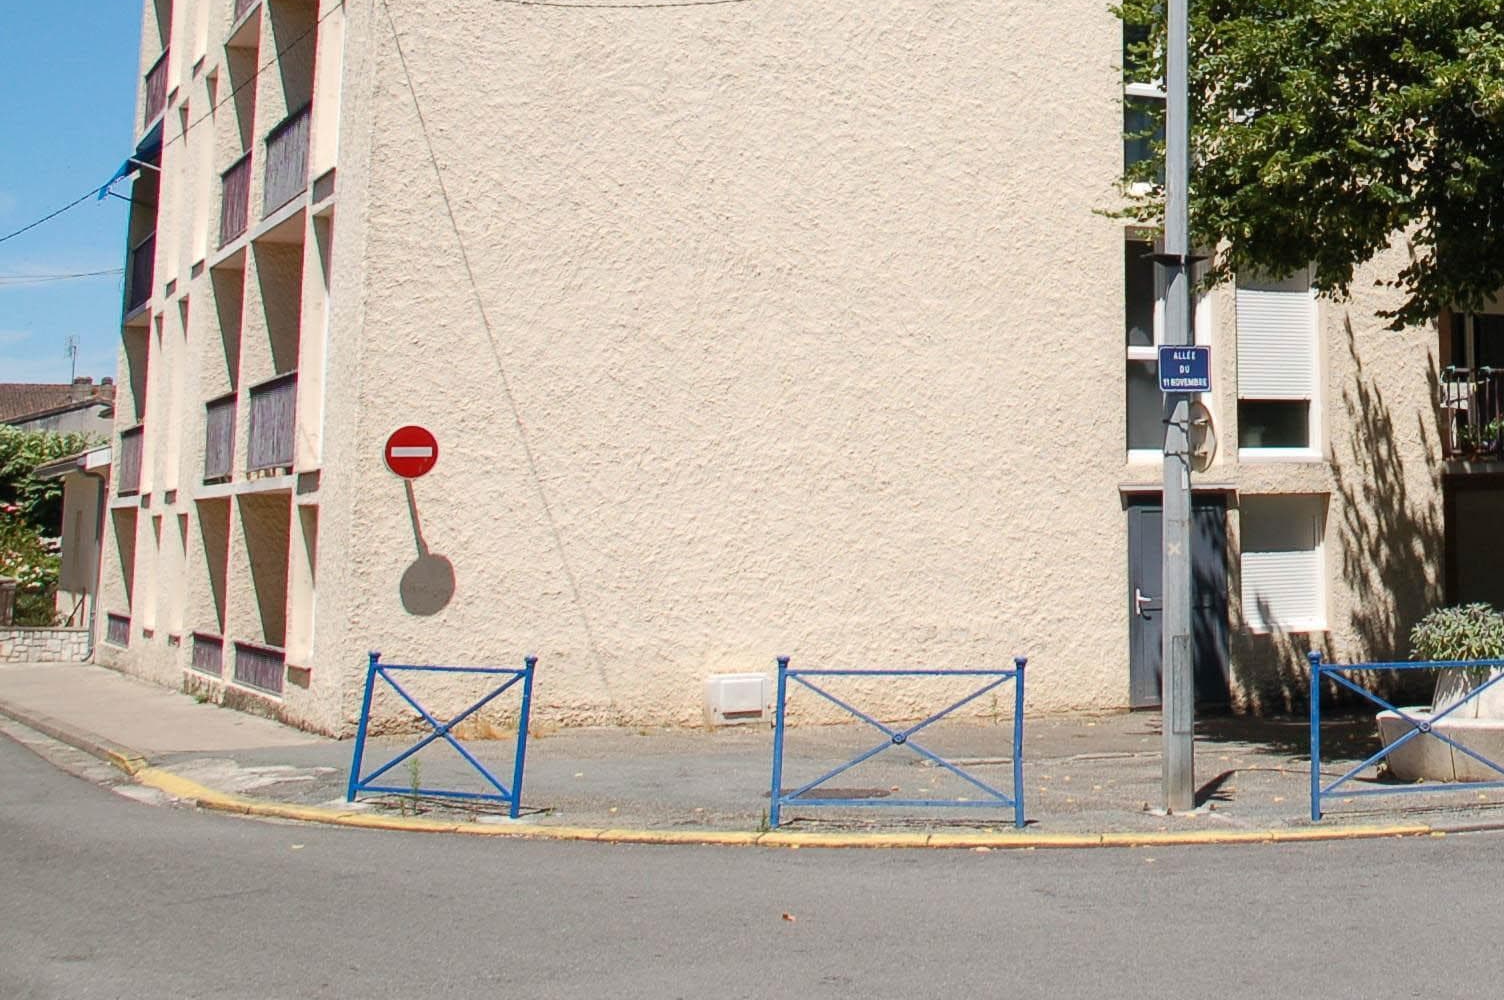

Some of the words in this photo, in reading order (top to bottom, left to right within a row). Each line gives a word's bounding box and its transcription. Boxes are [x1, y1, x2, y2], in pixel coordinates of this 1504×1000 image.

[1173, 350, 1196, 360] ALLÉE
[1179, 364, 1190, 374] DU
[1162, 378, 1170, 387] 11
[1170, 377, 1208, 387] NOVEMBRE
